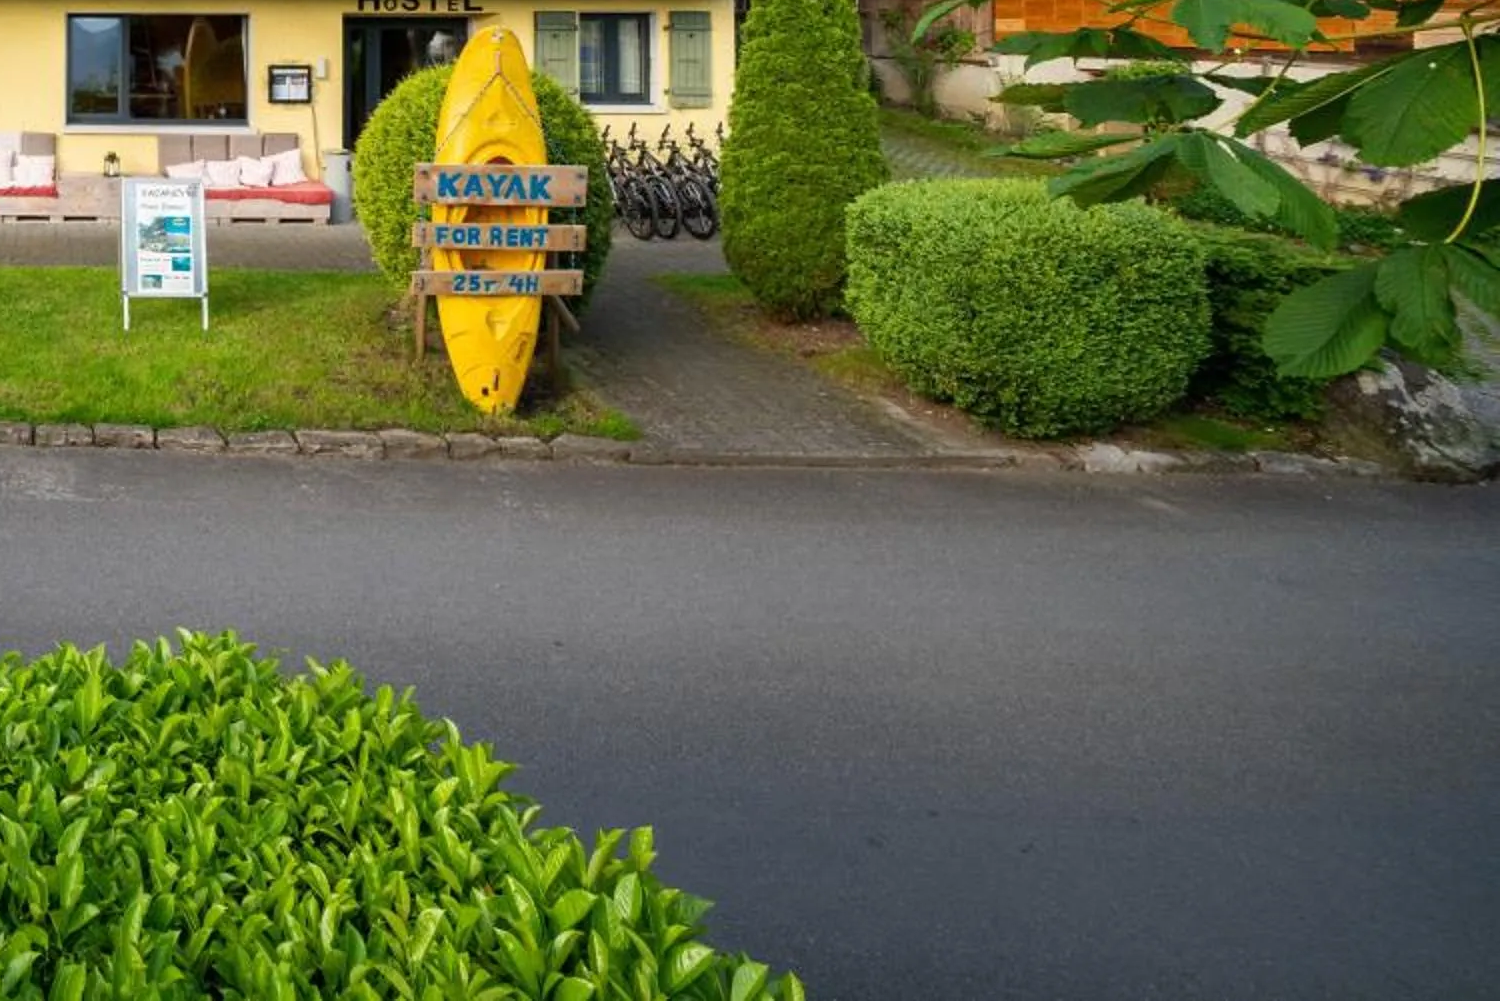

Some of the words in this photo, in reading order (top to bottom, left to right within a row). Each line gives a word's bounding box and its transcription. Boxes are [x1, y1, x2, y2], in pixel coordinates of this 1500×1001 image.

[436, 172, 552, 200] KAYAK
[435, 227, 481, 246] FOR
[490, 227, 549, 247] RENT
